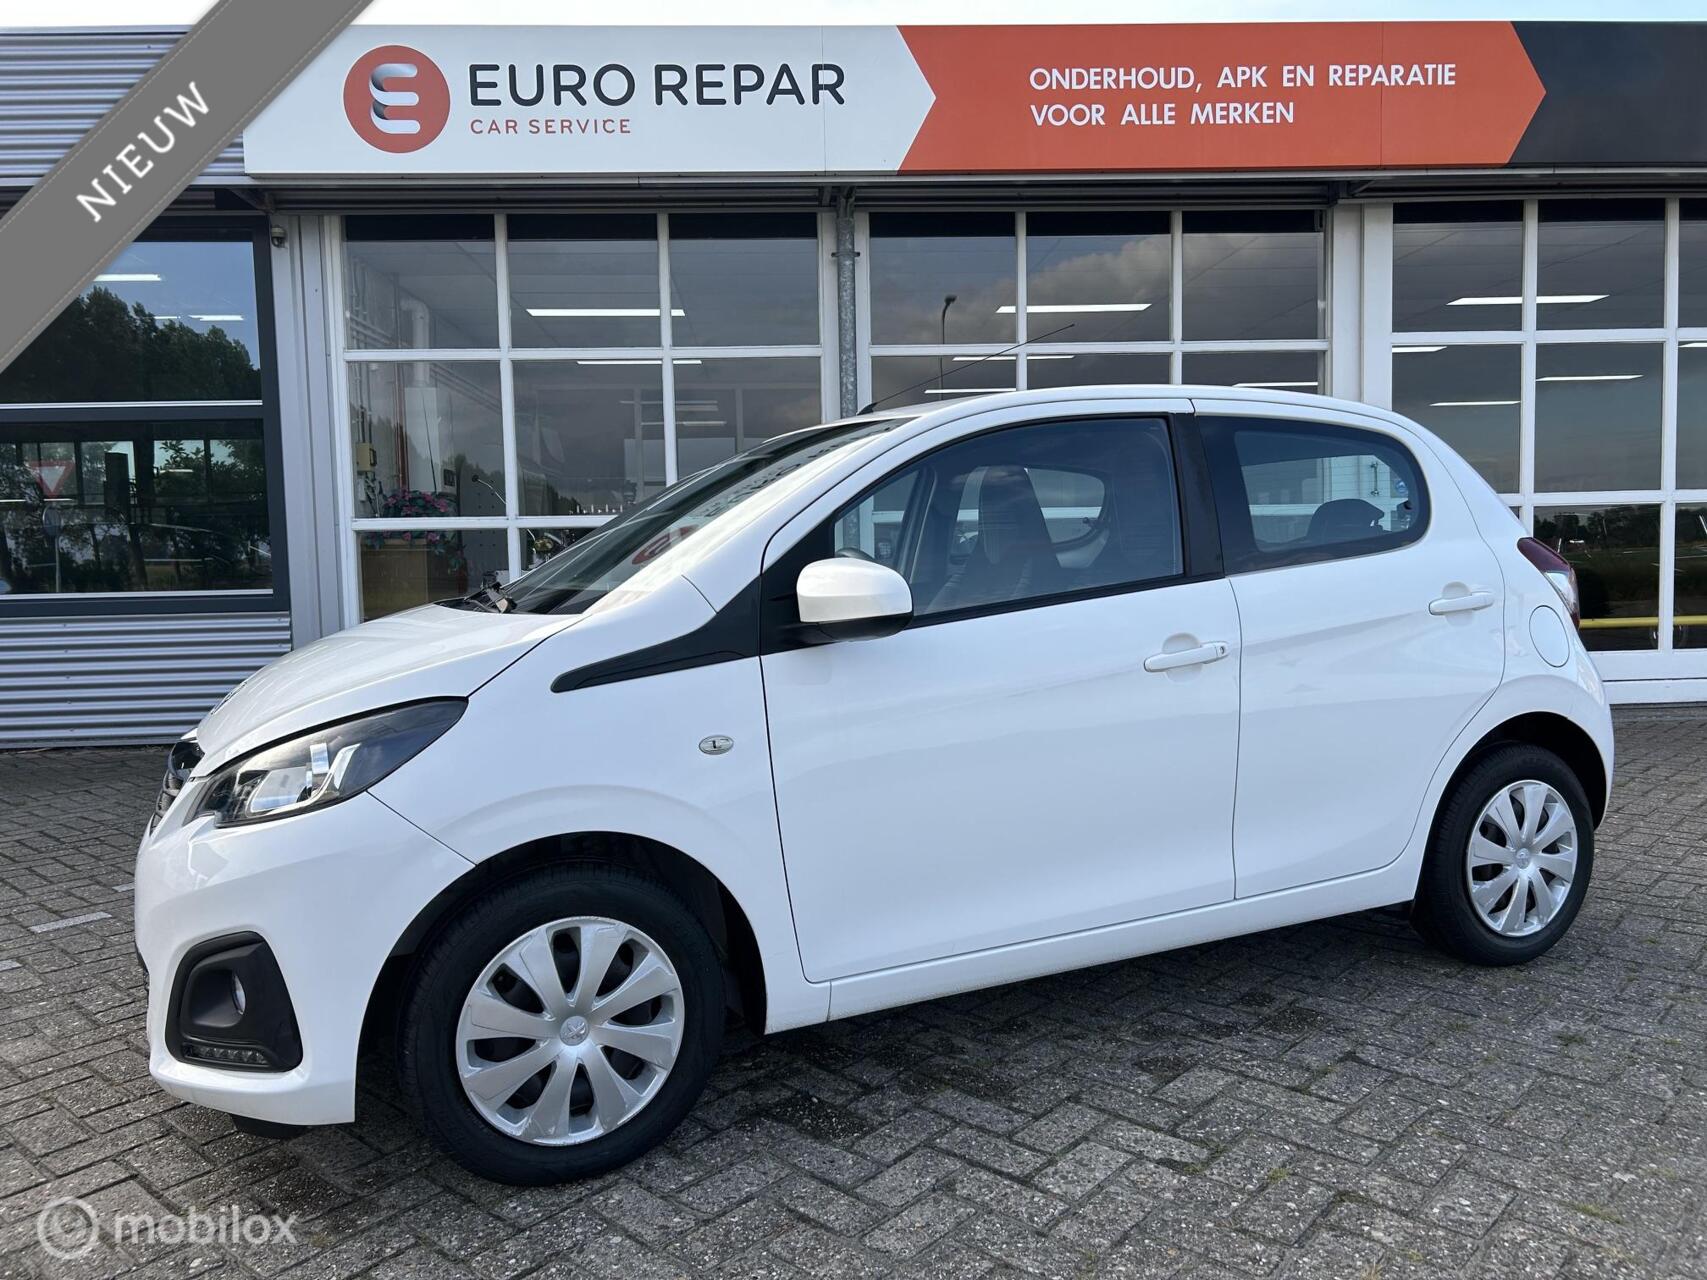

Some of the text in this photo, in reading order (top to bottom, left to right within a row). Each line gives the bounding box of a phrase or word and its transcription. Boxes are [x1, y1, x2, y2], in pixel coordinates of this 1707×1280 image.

[469, 63, 846, 107] EURO REPAR
[1029, 63, 1456, 93] ONDERHOUD, APK EN REPARATIE
[469, 118, 632, 135] CAR SERVICE
[1030, 102, 1294, 127] VOOR ALLE MERKEN
